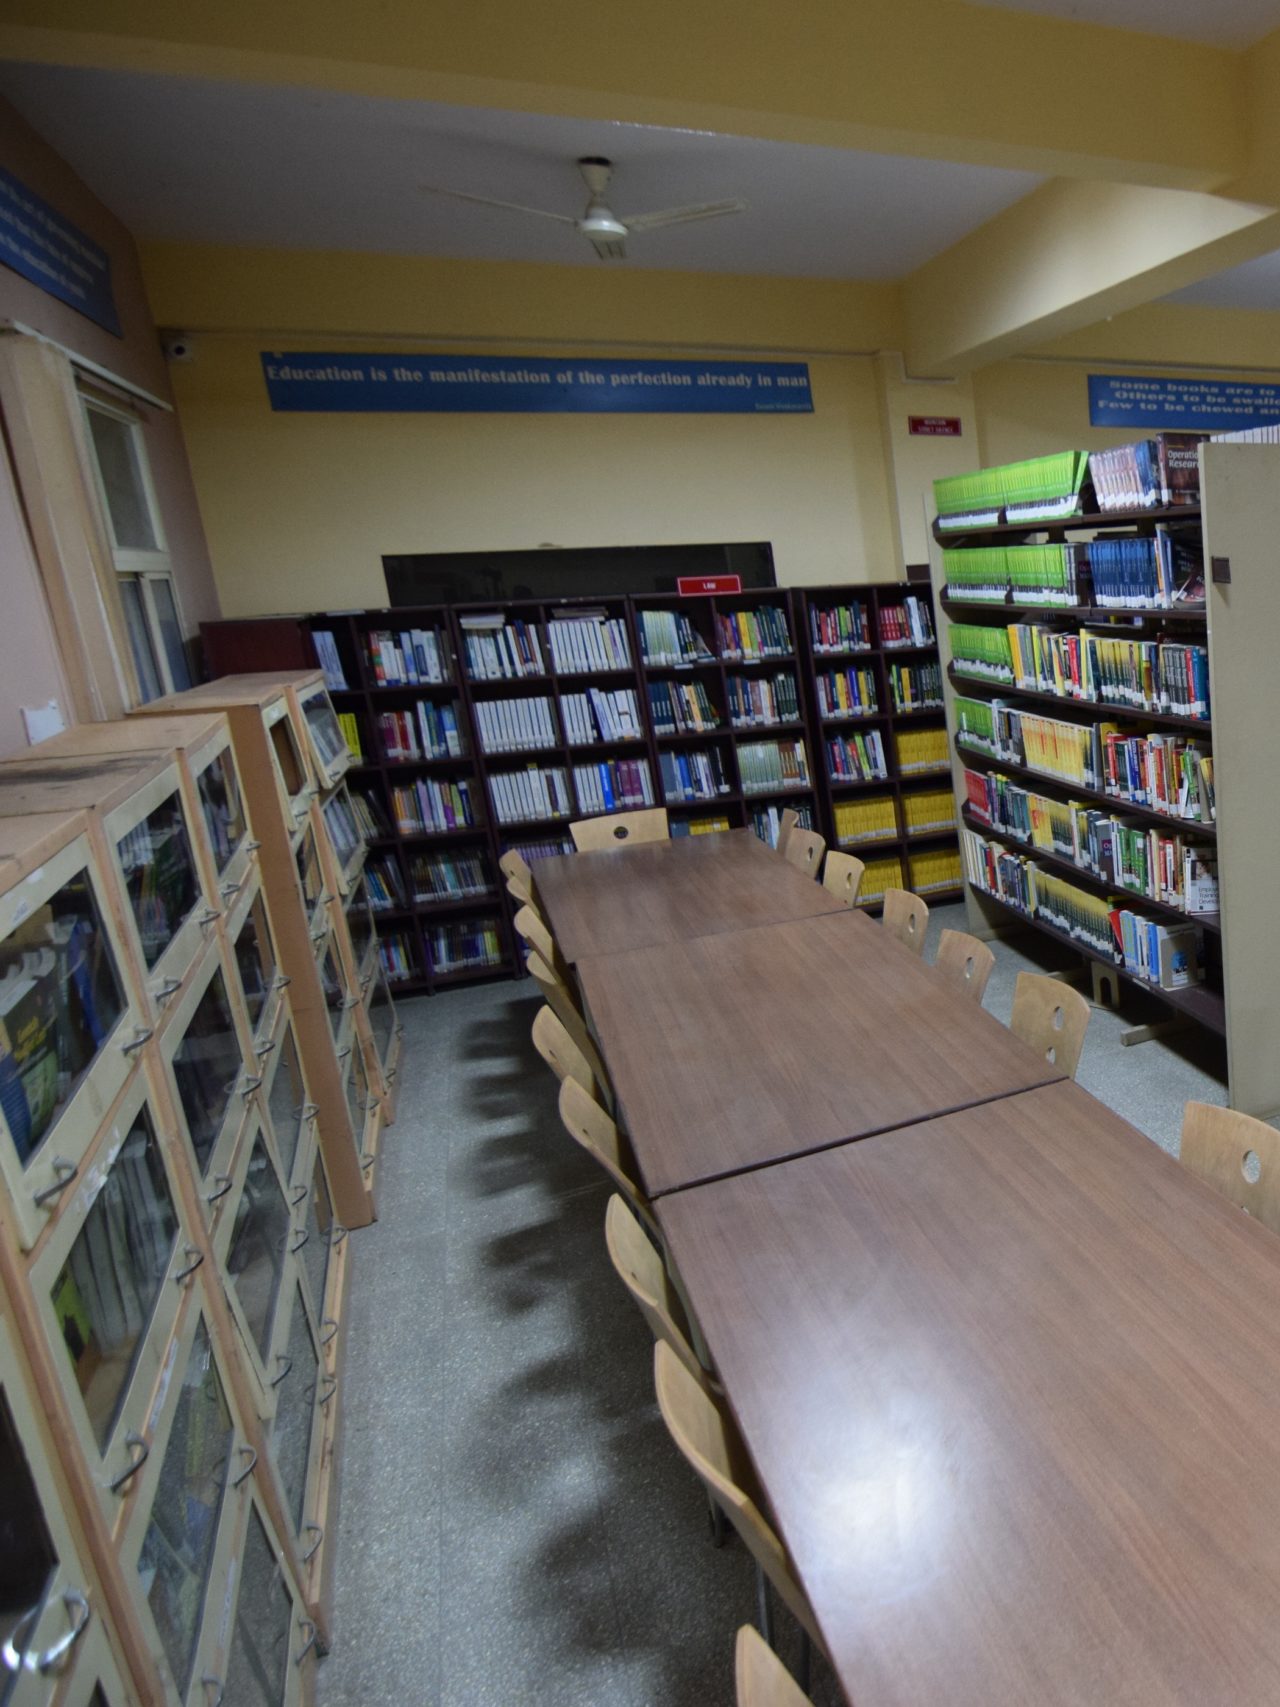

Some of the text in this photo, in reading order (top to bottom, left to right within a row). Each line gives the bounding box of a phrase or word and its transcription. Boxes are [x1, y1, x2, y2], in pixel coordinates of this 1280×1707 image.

[267, 365, 807, 388] Education is the manifestation of the perfection already in man
[1109, 380, 1160, 391] Some
[1167, 381, 1219, 394] books
[1226, 386, 1253, 395] are
[1259, 386, 1276, 396] to
[1115, 390, 1173, 402] Others
[1182, 392, 1201, 403] to
[1206, 393, 1226, 404] be
[1097, 399, 1134, 410] Few
[1140, 401, 1157, 411] to
[1164, 401, 1185, 412] be
[1192, 403, 1254, 415] chewed
